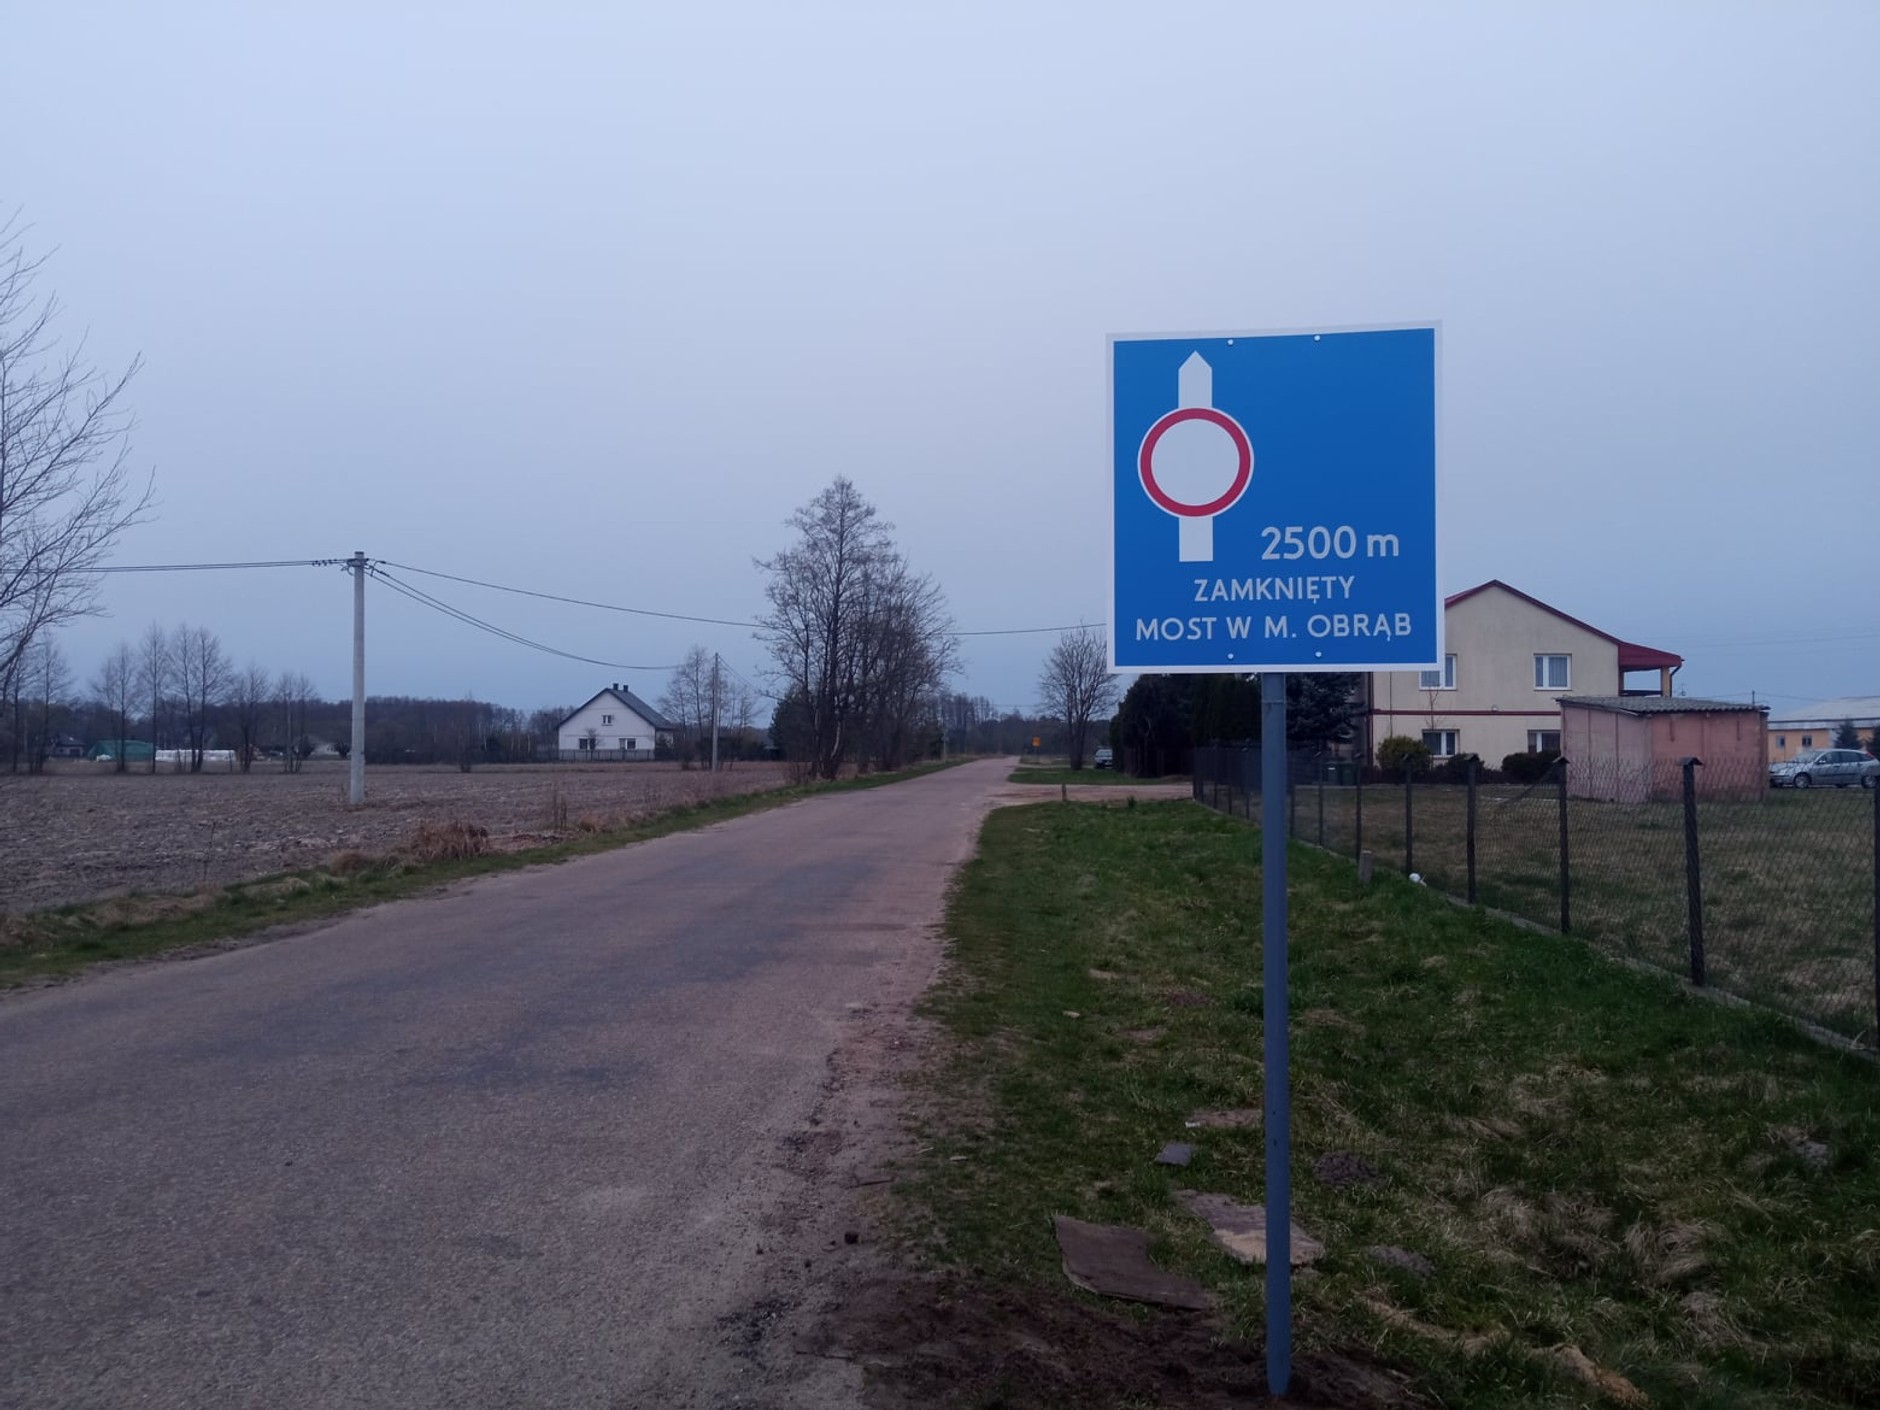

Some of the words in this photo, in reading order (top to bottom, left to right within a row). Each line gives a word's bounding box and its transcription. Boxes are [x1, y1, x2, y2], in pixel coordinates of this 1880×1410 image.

[1260, 525, 1358, 560] 2500
[1366, 532, 1399, 558] m
[1194, 575, 1355, 604] ZAMKNIĘTY
[1136, 616, 1217, 641] MOST
[1226, 616, 1252, 640] W
[1264, 615, 1298, 639] M.
[1306, 612, 1412, 642] OBRĄB
